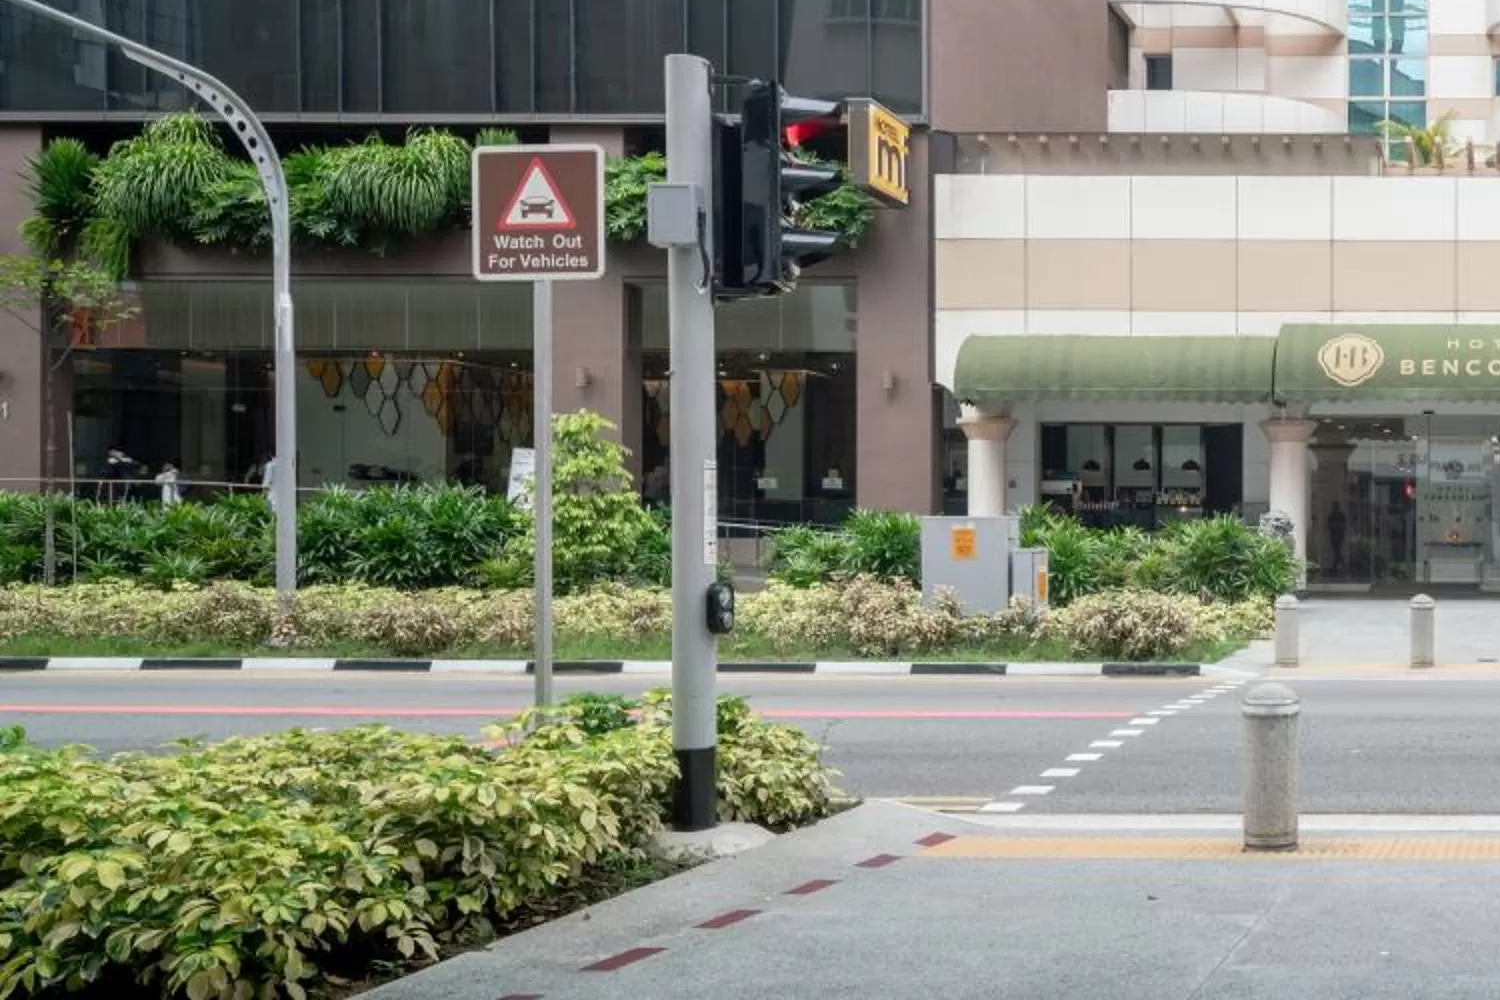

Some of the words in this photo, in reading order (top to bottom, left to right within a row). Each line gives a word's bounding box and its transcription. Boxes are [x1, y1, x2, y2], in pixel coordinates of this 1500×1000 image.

[493, 234, 545, 250] Watch
[552, 234, 583, 249] Out
[488, 254, 516, 269] For
[519, 253, 589, 268] Vehicles
